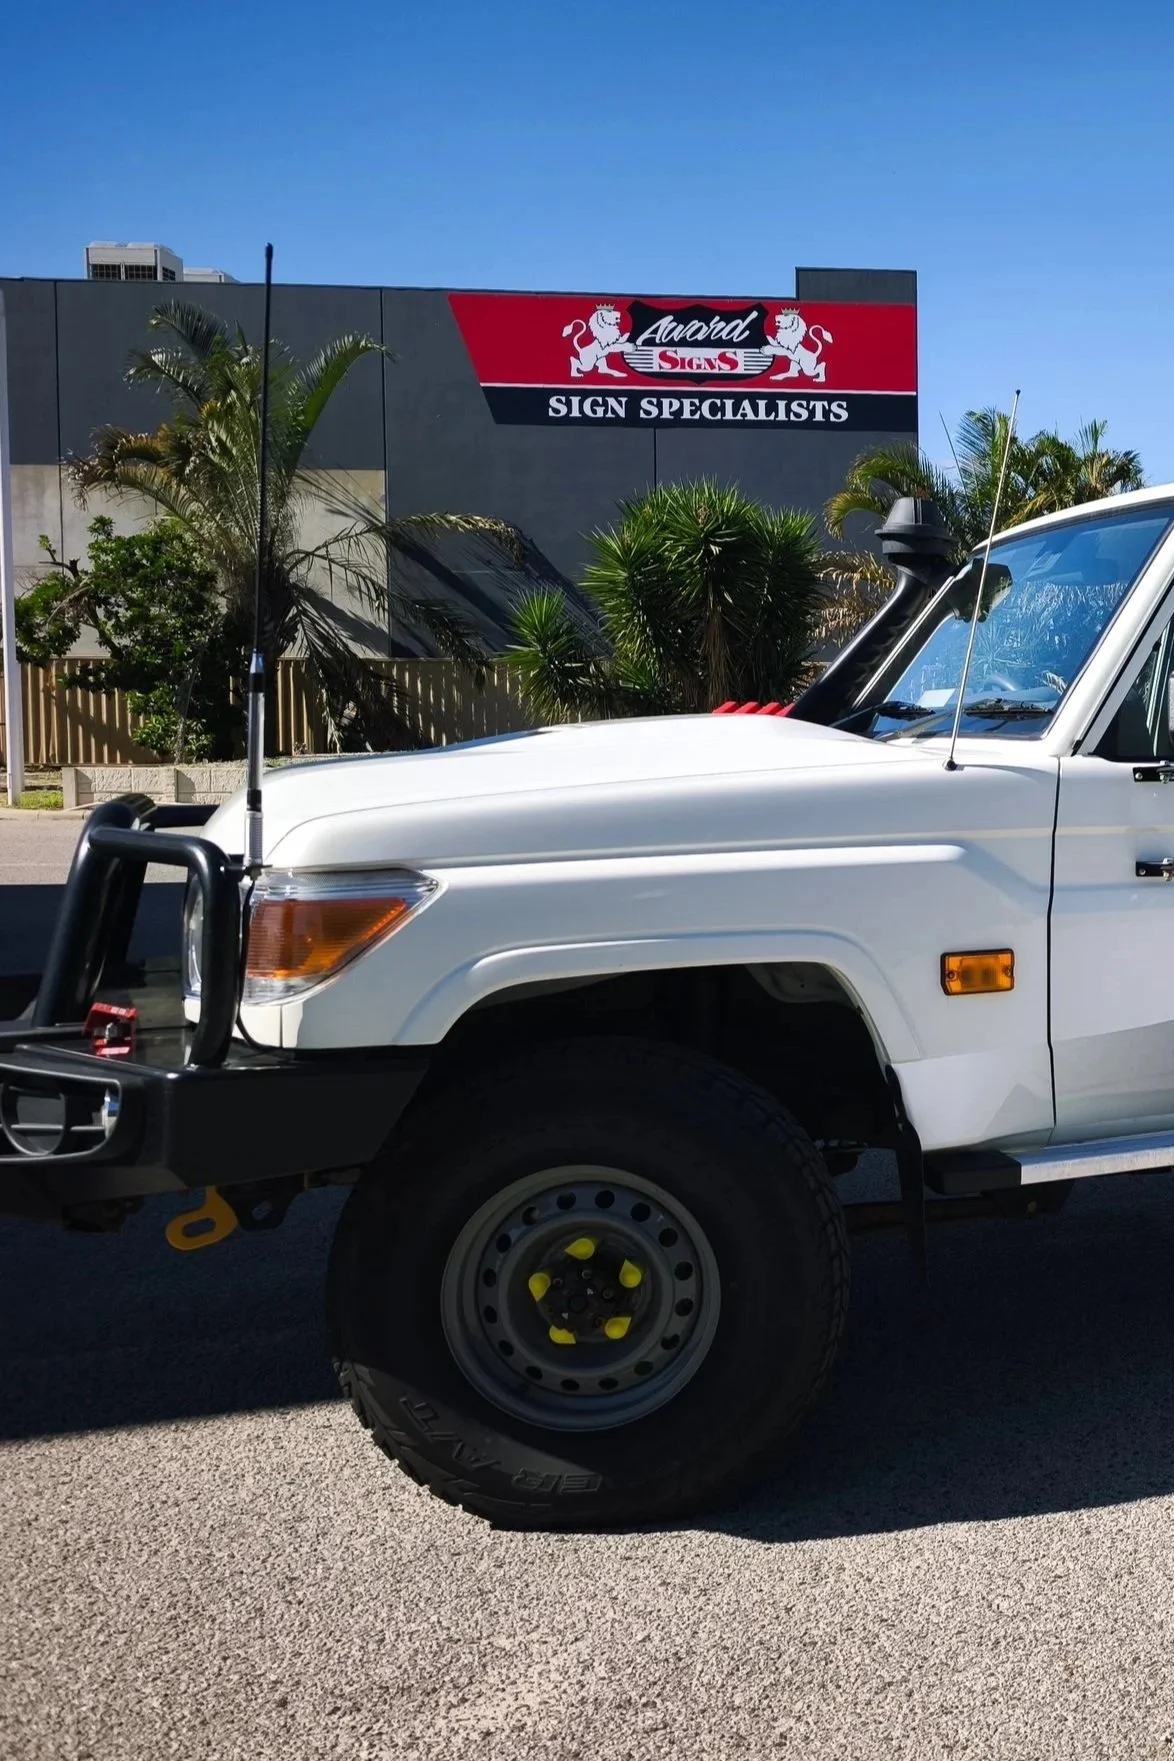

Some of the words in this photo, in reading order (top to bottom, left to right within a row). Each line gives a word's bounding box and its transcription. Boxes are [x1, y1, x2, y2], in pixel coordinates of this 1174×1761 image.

[636, 310, 759, 346] Award
[548, 395, 628, 418] SIGN
[639, 397, 849, 422] SPECIALISTS
